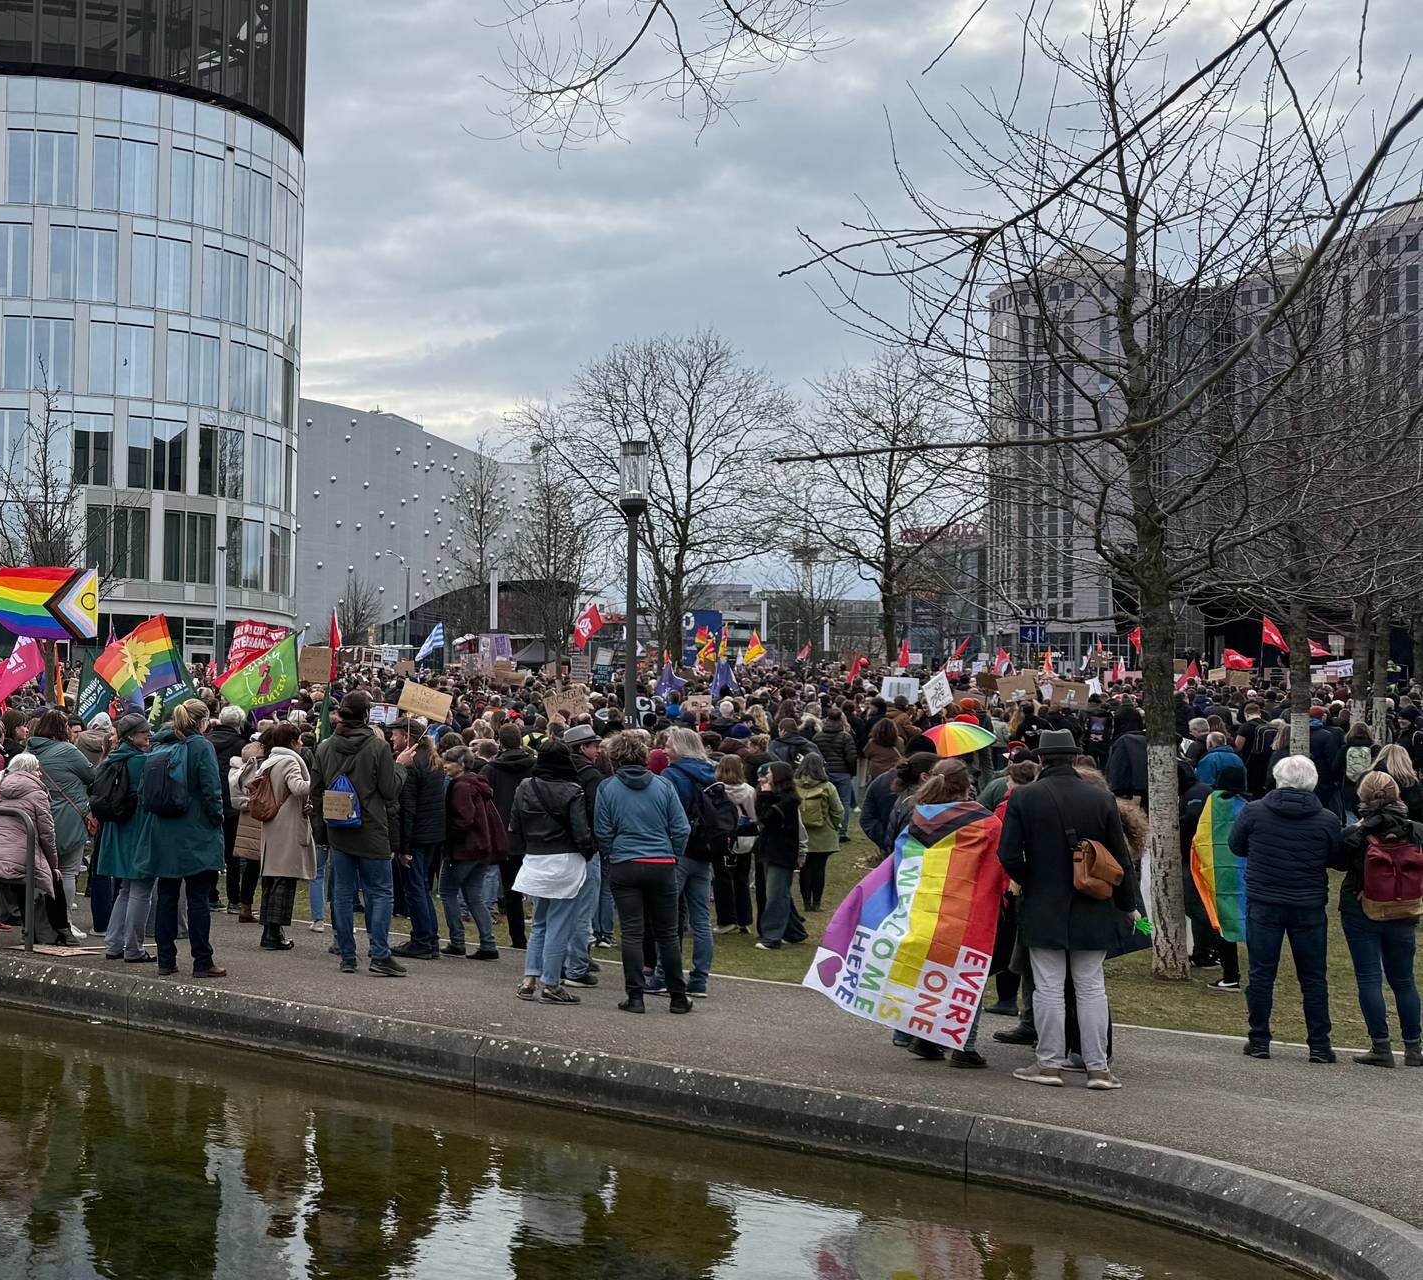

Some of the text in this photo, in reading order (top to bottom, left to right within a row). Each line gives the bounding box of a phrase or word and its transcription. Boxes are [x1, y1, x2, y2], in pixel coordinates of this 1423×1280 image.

[835, 930, 871, 1004] HERE
[940, 951, 988, 1045] EVERY
[878, 994, 914, 1022] IS
[908, 970, 948, 1034] ONE
